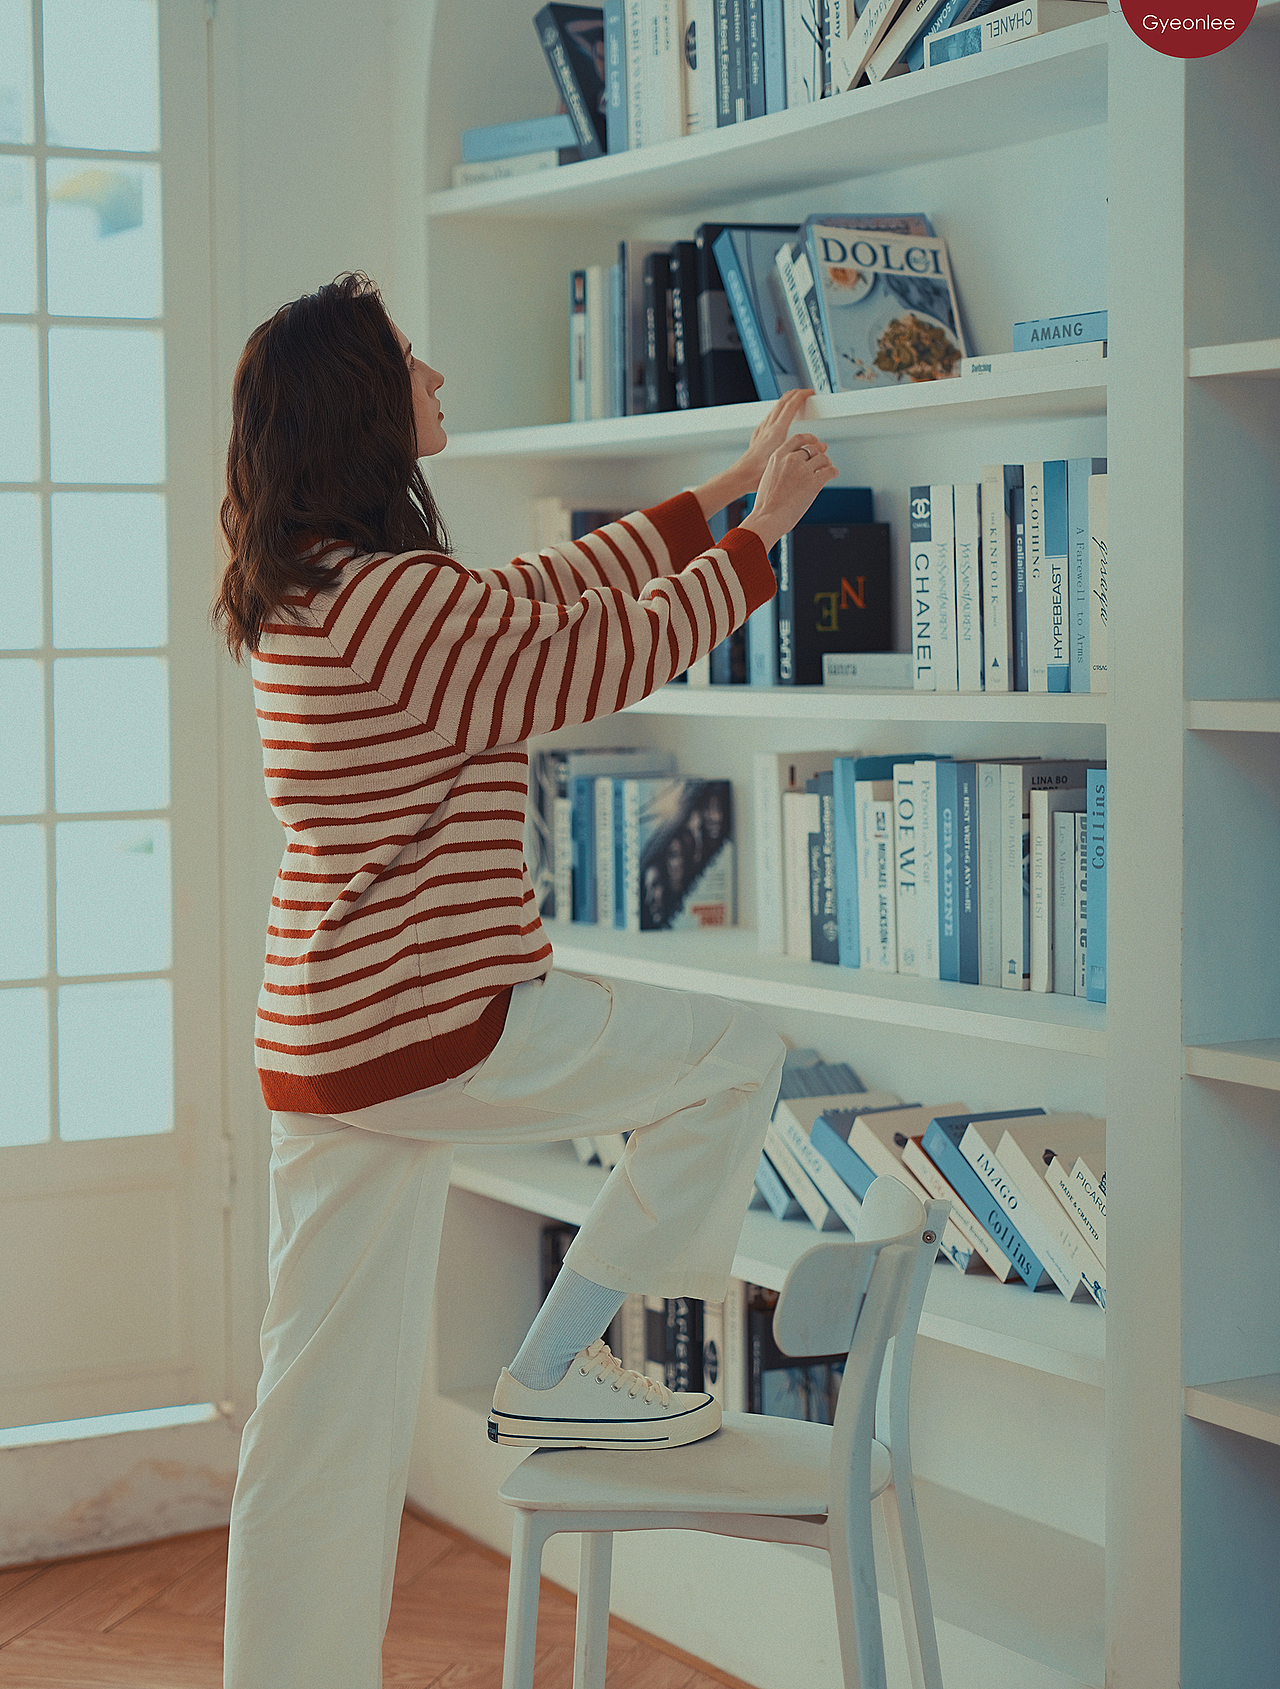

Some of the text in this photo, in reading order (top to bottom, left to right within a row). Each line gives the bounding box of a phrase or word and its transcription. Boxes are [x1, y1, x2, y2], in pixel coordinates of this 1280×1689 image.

[720, 18, 729, 52] Most
[750, 12, 759, 48] Tom's
[986, 8, 1033, 39] CHANEL
[721, 53, 731, 115] Excellent
[751, 51, 760, 85] Cabin
[820, 236, 944, 275] DOLCI
[1031, 322, 1084, 343] AMANG
[1030, 484, 1041, 580] CLOTHING
[1076, 527, 1084, 535] A
[989, 526, 999, 604] KINFOLK
[1076, 543, 1085, 602] Farewell
[914, 552, 932, 680] CHANEL
[1052, 564, 1063, 660] HYPEBEAST
[1078, 611, 1084, 626] to
[921, 780, 930, 831] Person
[1031, 776, 1068, 785] LINA BO
[897, 779, 916, 898] LOEWE
[1092, 783, 1106, 871] Collins
[823, 855, 832, 889] Most
[877, 842, 889, 944] MICHAEL JACKSON
[823, 890, 833, 915] The
[976, 1153, 1019, 1210] IMAGO
[1058, 1179, 1071, 1201] MADE
[1078, 1207, 1100, 1241] CRAFTED
[987, 1209, 1033, 1276] Collins
